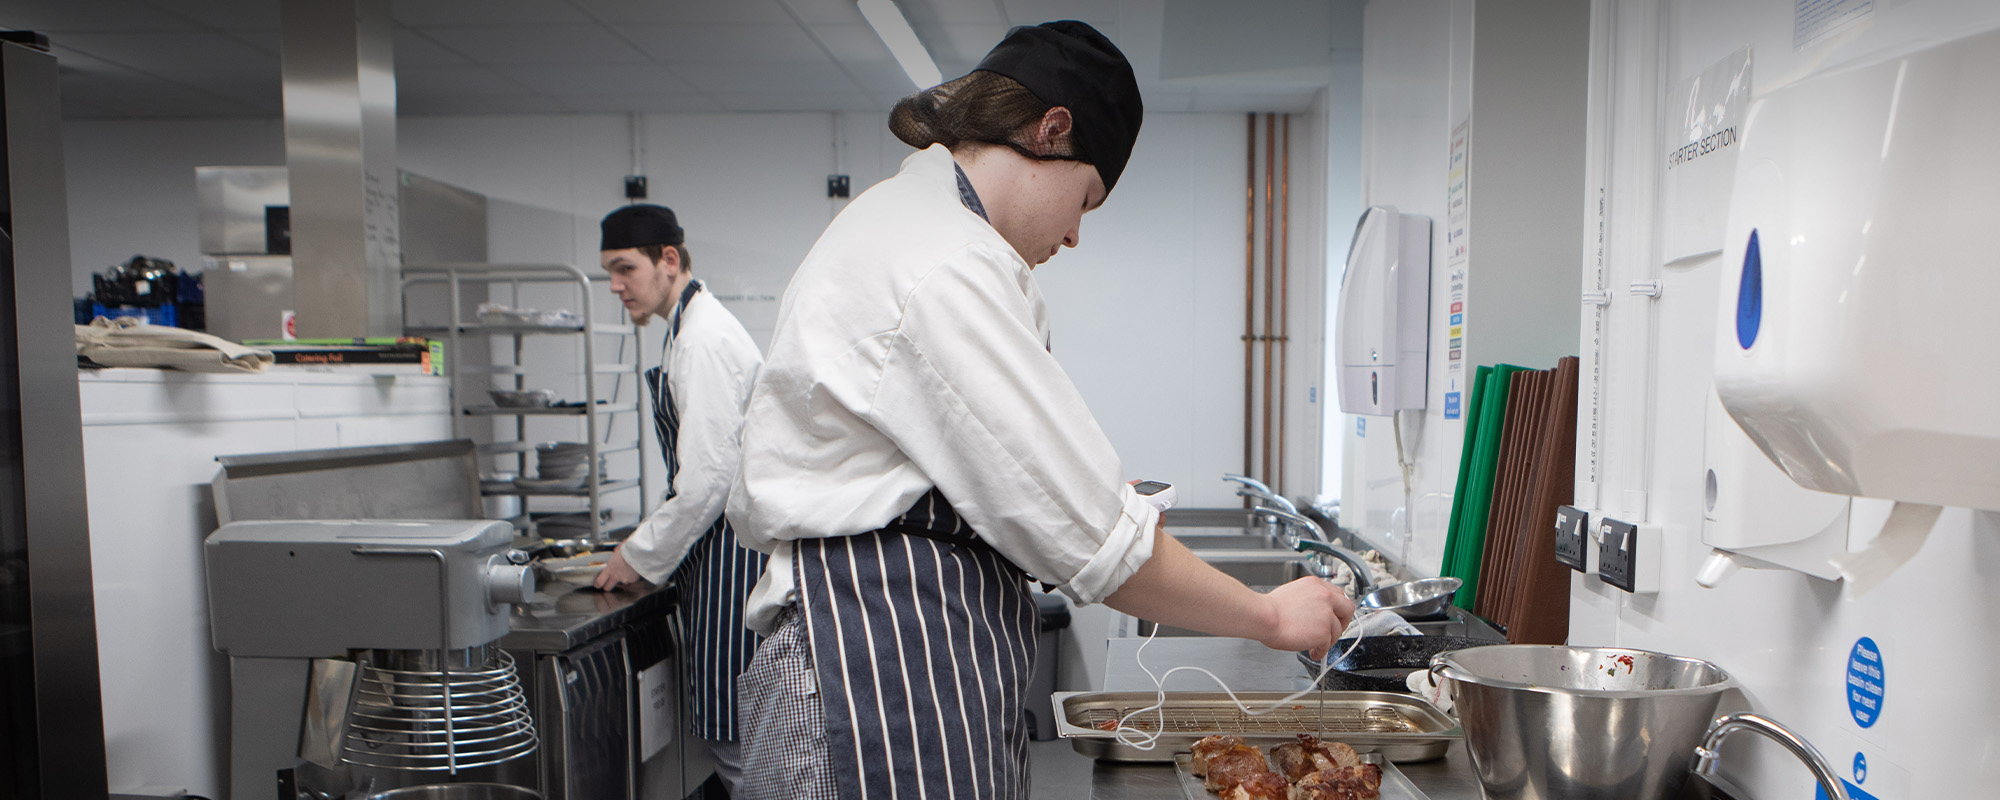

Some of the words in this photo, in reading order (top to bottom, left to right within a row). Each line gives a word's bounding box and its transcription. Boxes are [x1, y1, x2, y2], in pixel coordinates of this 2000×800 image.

[1668, 142, 1699, 170] STARTER
[1700, 125, 1736, 156] SECTION
[1857, 643, 1878, 662] Please
[1852, 657, 1868, 675] leave
[1868, 664, 1881, 680] this
[1848, 671, 1865, 689] basin
[1865, 680, 1882, 697] clean
[1852, 689, 1862, 703] for
[1861, 695, 1876, 710] next
[1855, 708, 1870, 723] user
